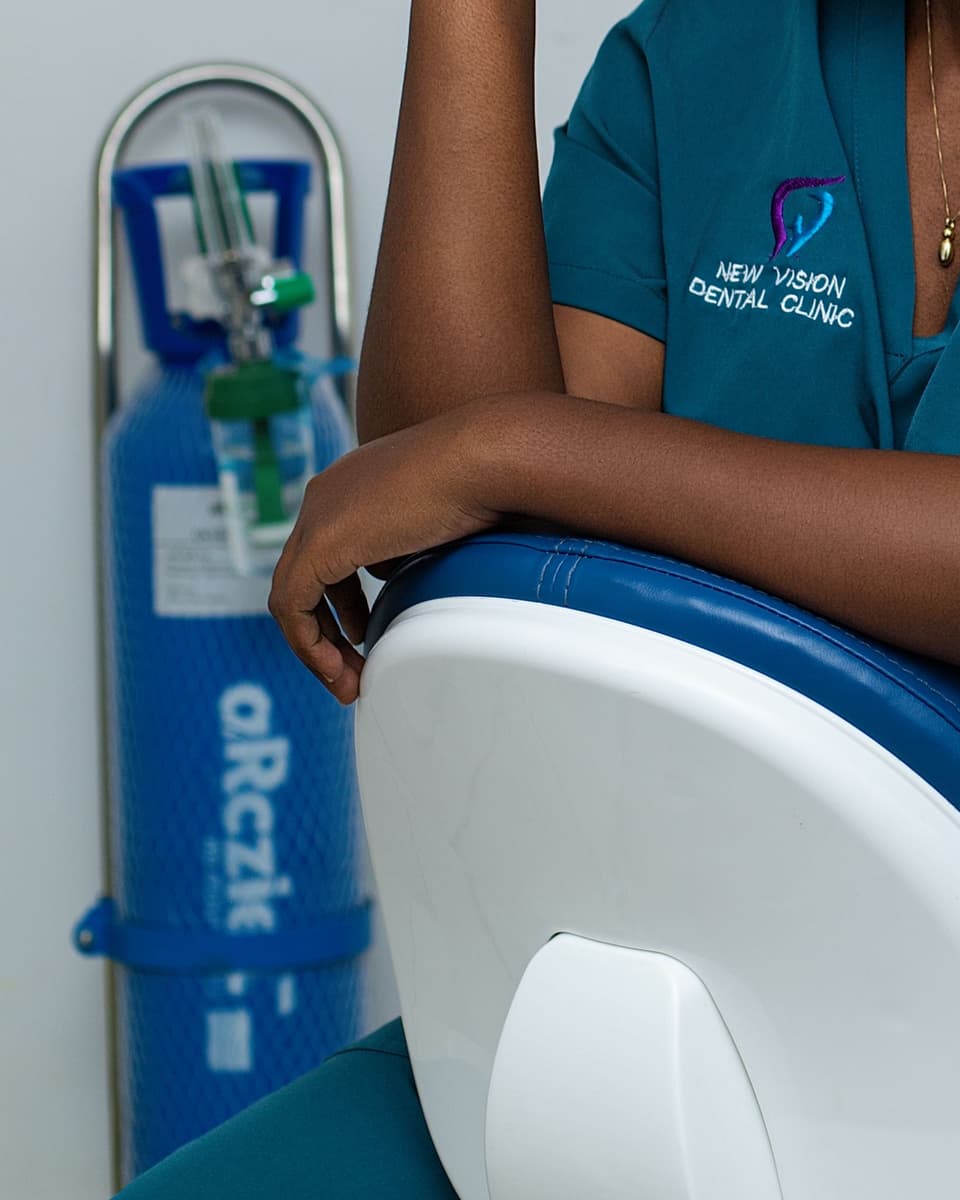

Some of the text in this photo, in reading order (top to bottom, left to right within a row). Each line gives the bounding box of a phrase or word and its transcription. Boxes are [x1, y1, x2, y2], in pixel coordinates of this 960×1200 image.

[688, 275, 855, 328] DENTAL CLINIC
[715, 260, 847, 300] NEW VISION
